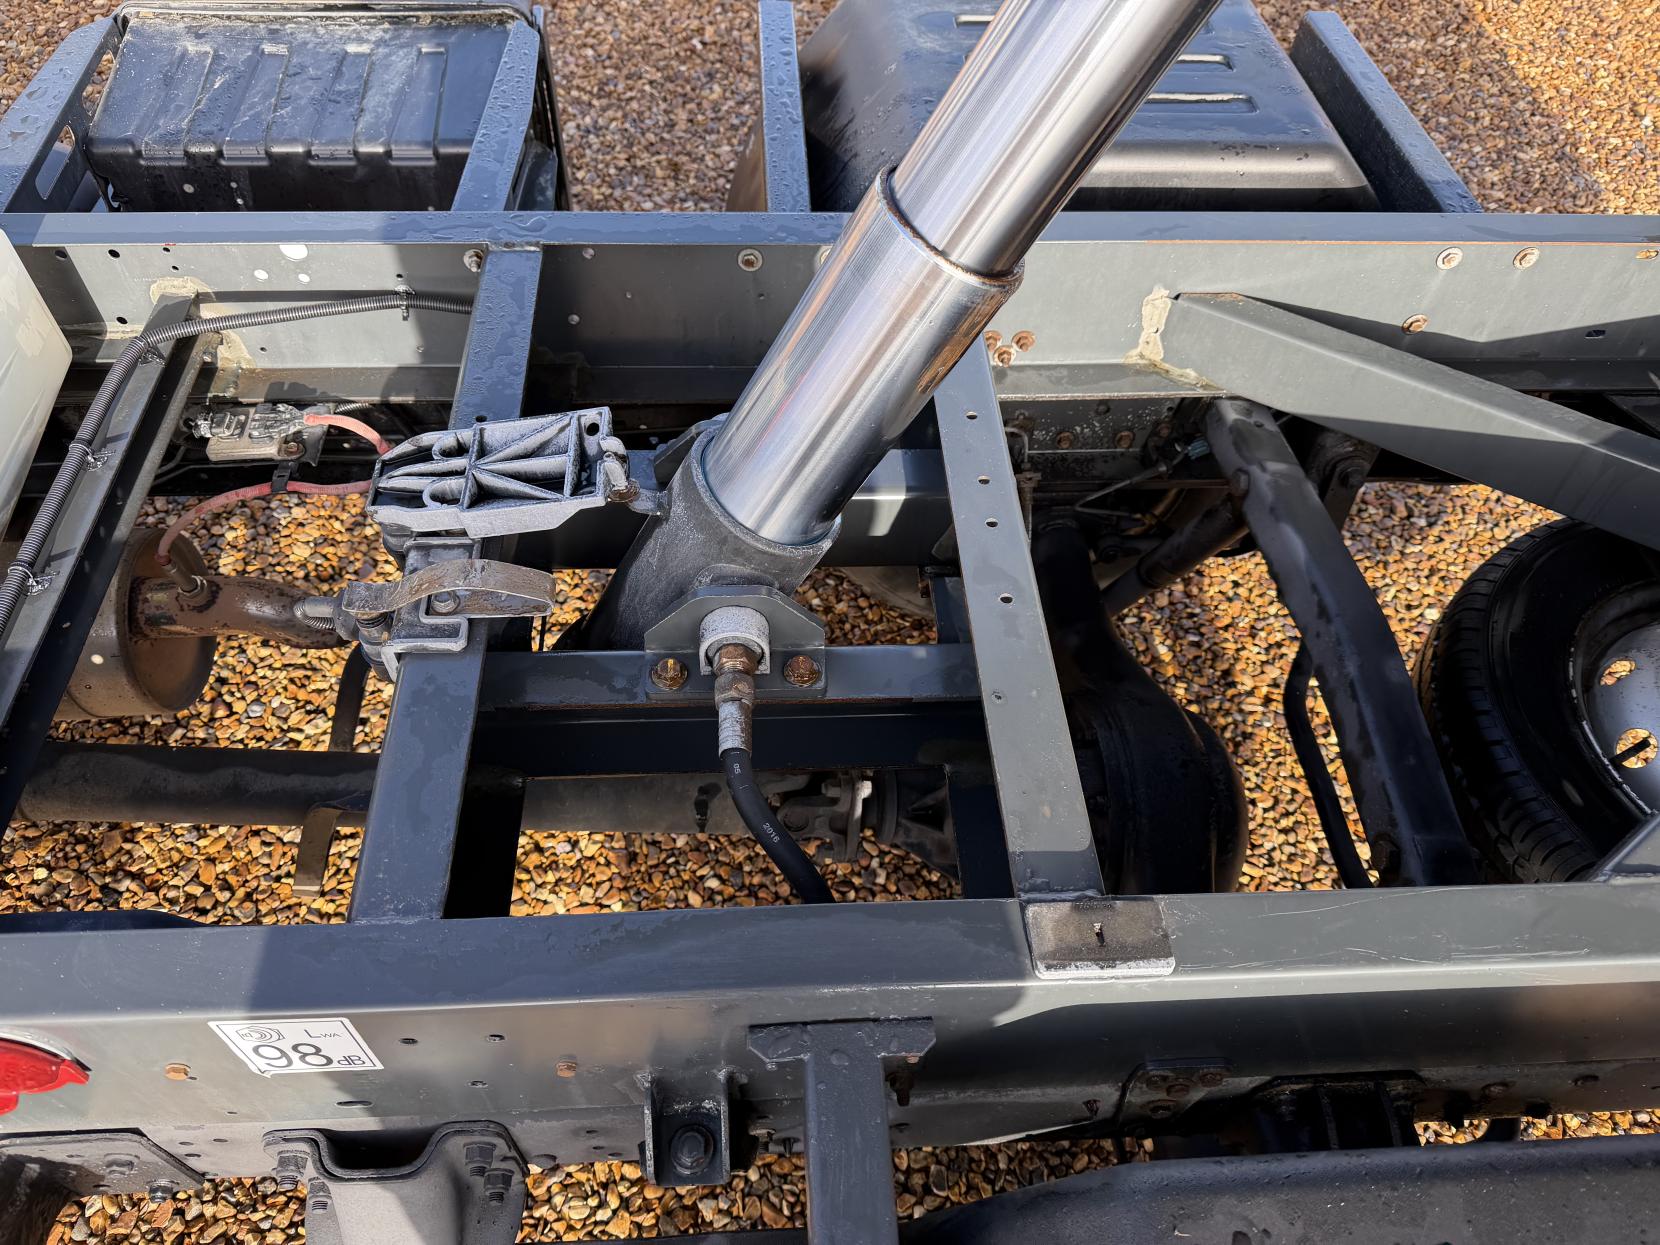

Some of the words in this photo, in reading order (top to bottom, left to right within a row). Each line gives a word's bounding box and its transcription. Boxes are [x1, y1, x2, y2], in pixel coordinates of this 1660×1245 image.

[762, 822, 780, 843] 2016
[252, 1042, 334, 1068] 98
[337, 1055, 366, 1066] dB
